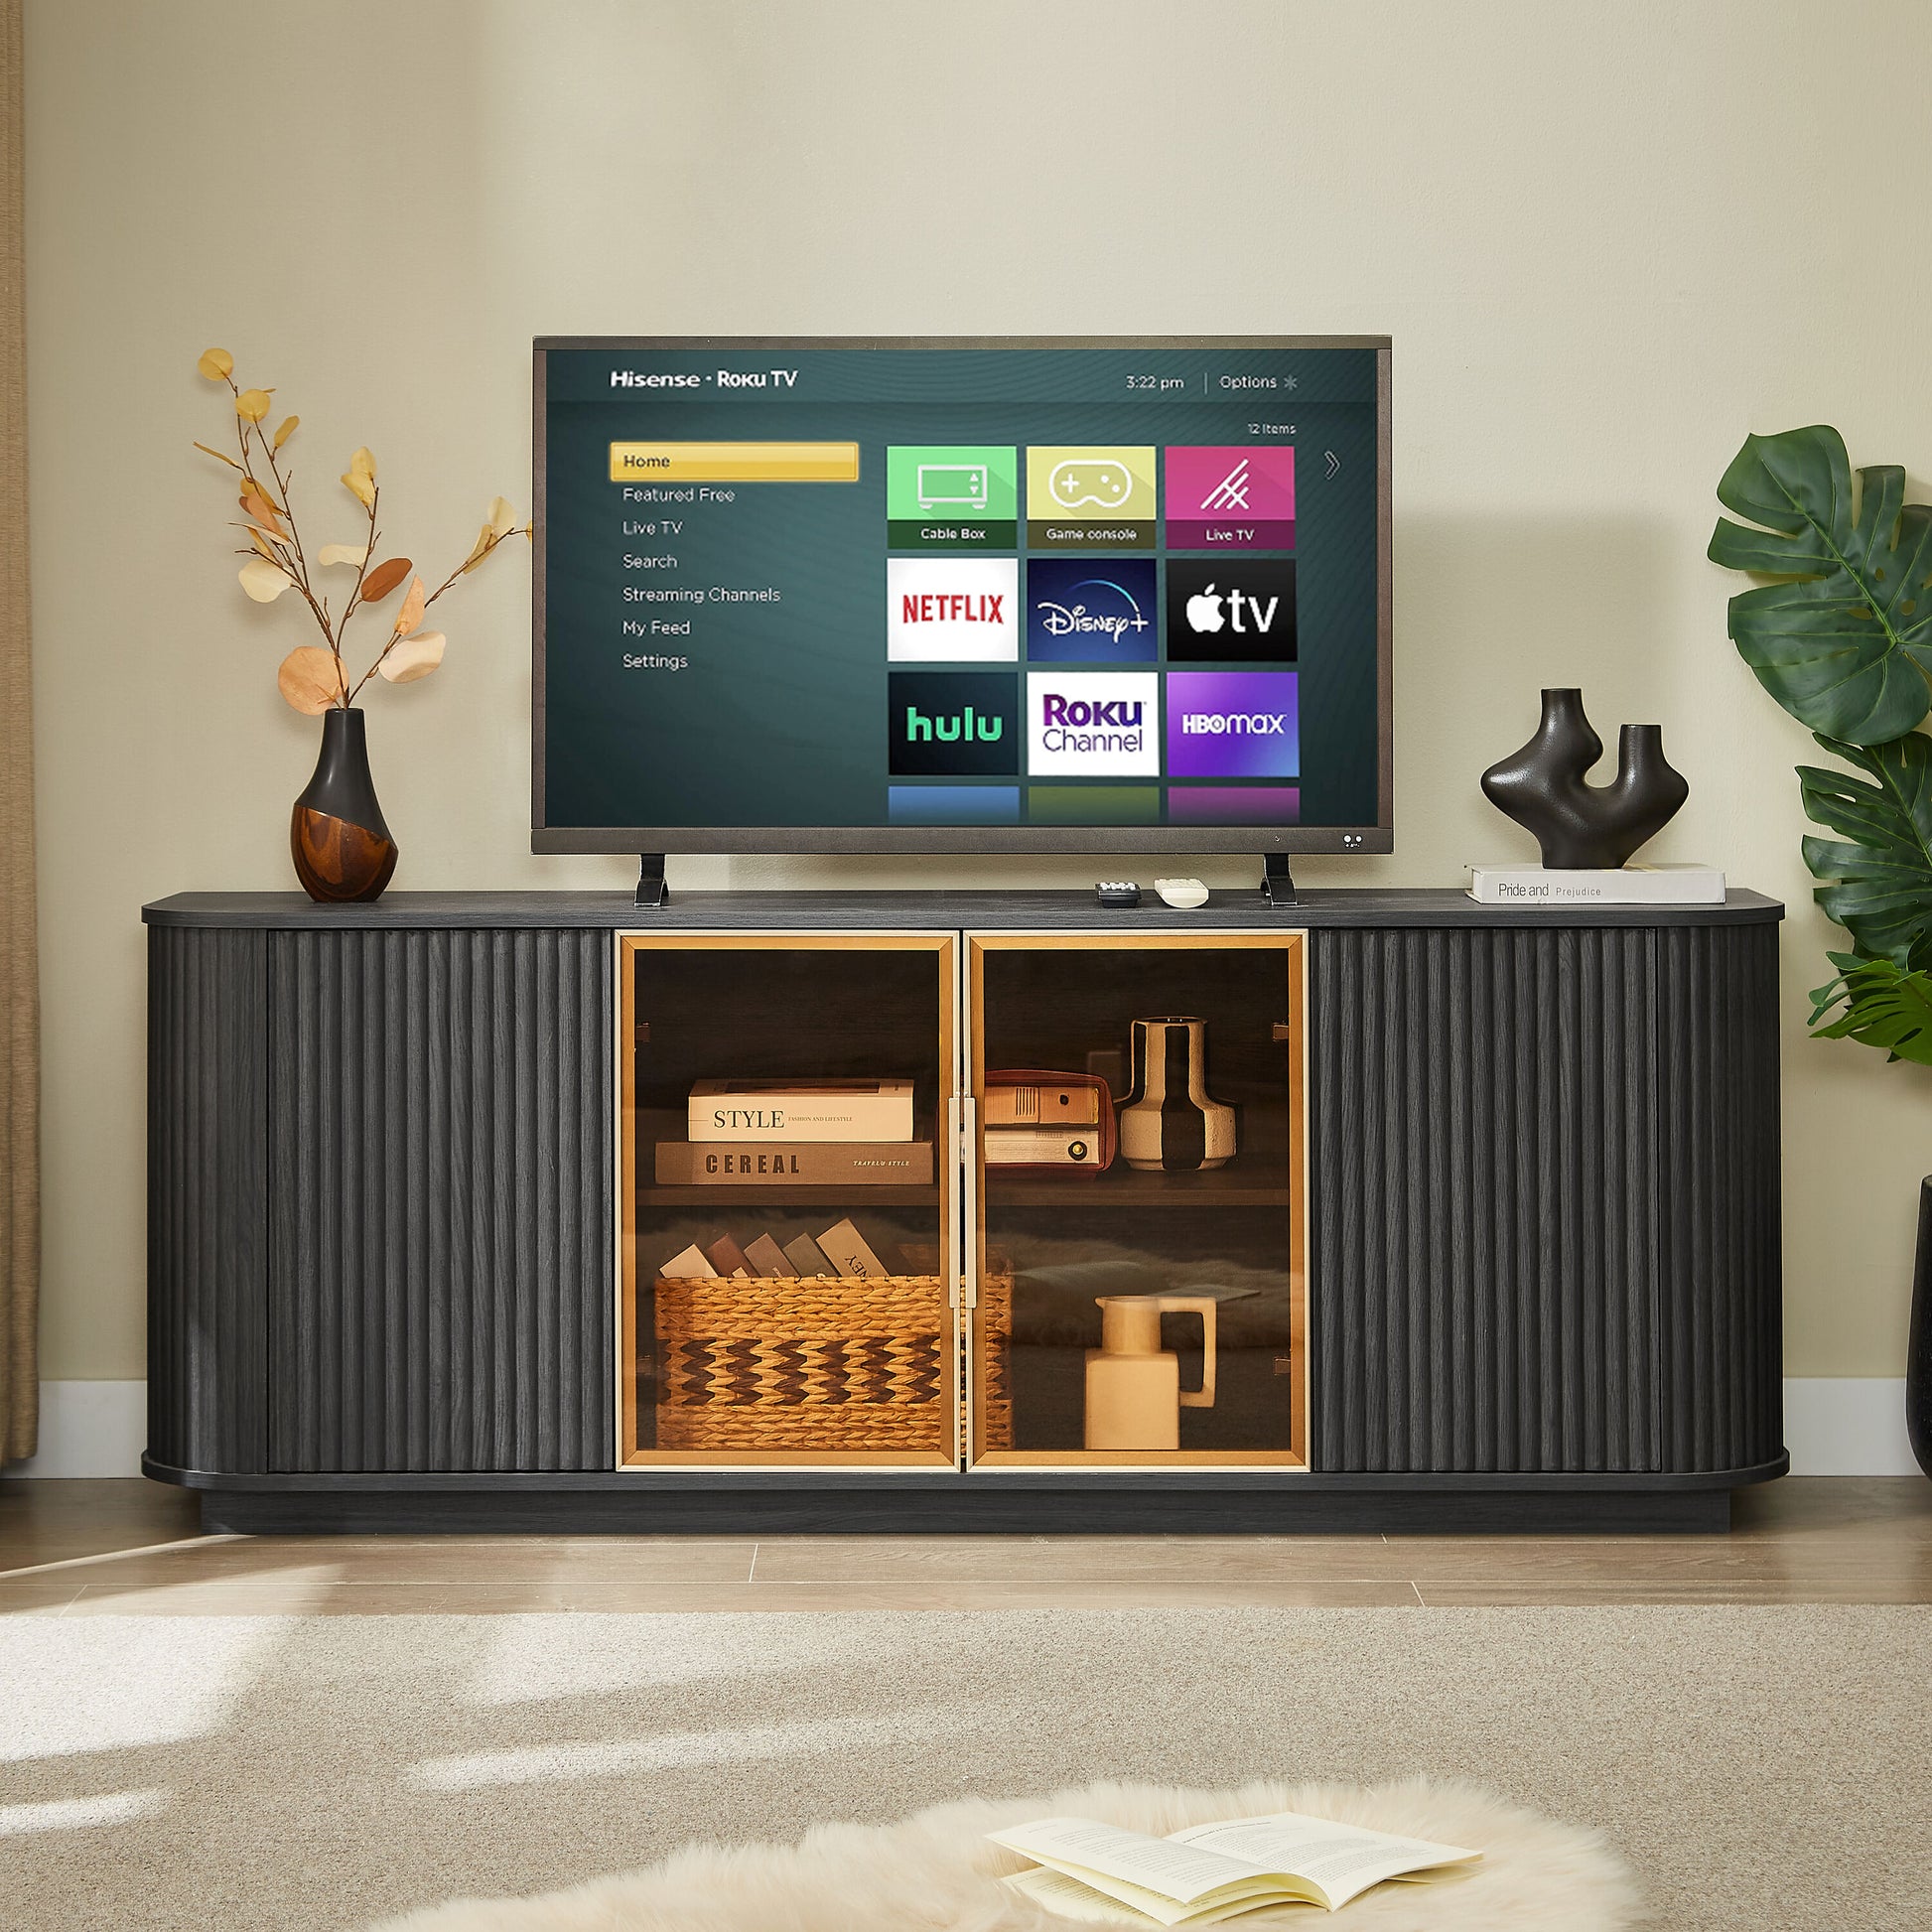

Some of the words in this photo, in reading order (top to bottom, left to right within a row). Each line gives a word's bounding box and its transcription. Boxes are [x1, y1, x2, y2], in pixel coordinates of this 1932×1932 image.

[612, 370, 700, 388] Hisense
[717, 370, 766, 388] Roku
[770, 370, 798, 387] TV
[1126, 375, 1157, 389] 3:22
[1161, 379, 1184, 391] pm
[1219, 375, 1278, 390] Options
[1247, 424, 1260, 435] 12
[1262, 424, 1297, 435] Items
[623, 454, 670, 468] Home
[622, 487, 694, 502] Featured
[699, 487, 736, 502] Free
[622, 521, 656, 535] Live
[660, 521, 683, 534] TV
[920, 528, 957, 539] Cable
[961, 528, 986, 539] Box
[1045, 528, 1081, 540] Game
[1086, 528, 1137, 540] console
[1206, 528, 1232, 541] Live
[1235, 529, 1255, 541] TV
[622, 554, 678, 569] Search
[622, 587, 705, 604] Streaming
[709, 587, 781, 602] Channels
[902, 595, 1004, 624] NETFLIX
[1227, 589, 1279, 632] tv
[622, 621, 646, 636] My
[651, 621, 691, 634] Feed
[622, 653, 688, 671] Settings
[1043, 694, 1143, 727] Roku
[907, 707, 1002, 742] hulu
[1043, 730, 1143, 752] Channel
[1498, 883, 1526, 897] Pride
[1528, 883, 1549, 897] and
[1556, 887, 1601, 898] Prejudice
[714, 1110, 785, 1128] STYLE
[706, 1154, 799, 1174] CEREAL
